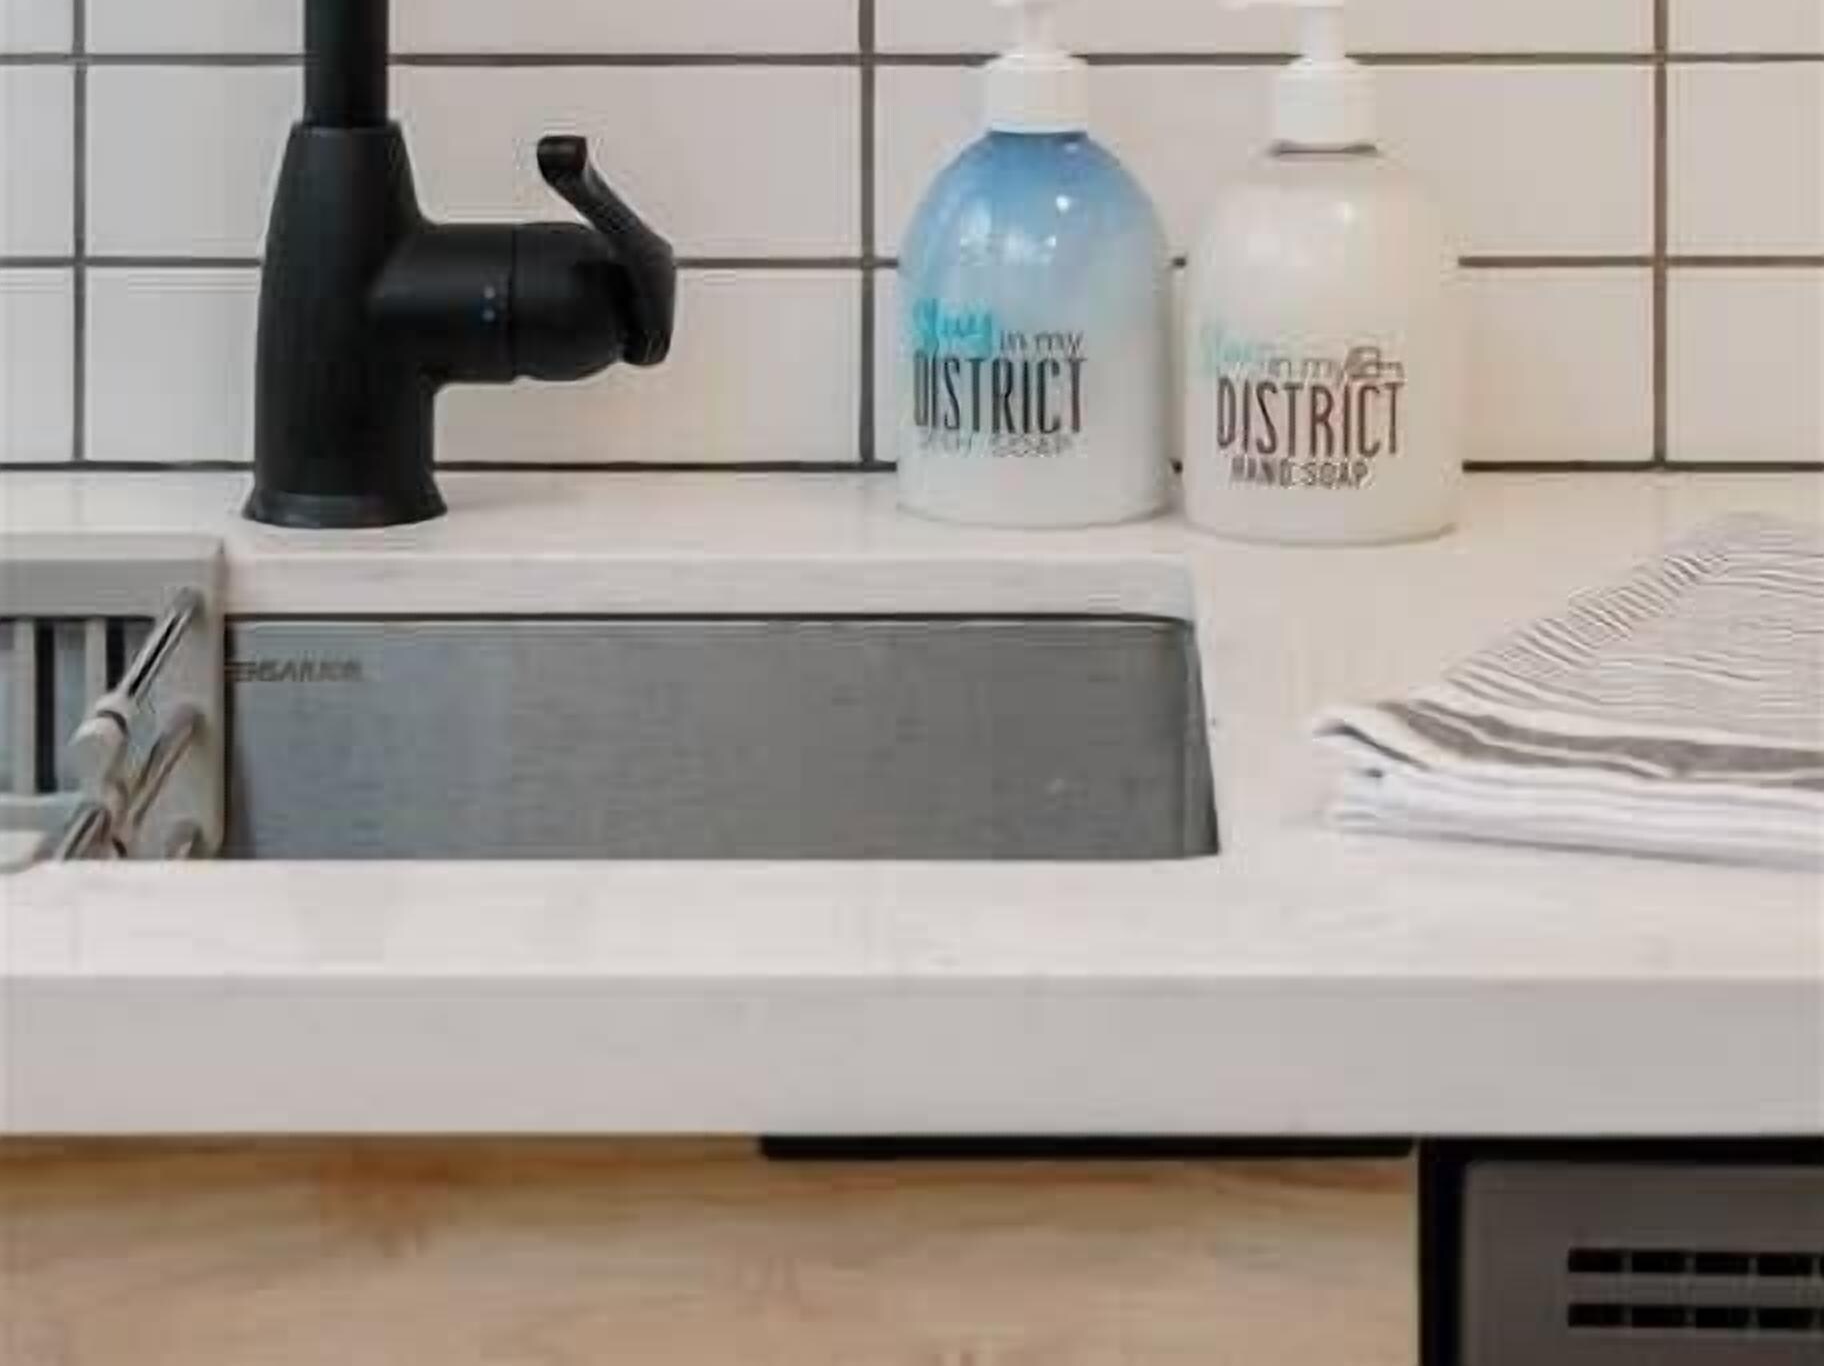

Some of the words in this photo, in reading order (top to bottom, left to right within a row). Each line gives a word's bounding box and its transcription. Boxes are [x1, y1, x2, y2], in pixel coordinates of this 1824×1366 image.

[999, 329, 1028, 352] in
[1035, 329, 1084, 357] my
[913, 349, 1087, 435] DISTRICT
[1216, 377, 1405, 458] DISTRICT
[1231, 456, 1294, 487] HAND
[1299, 459, 1371, 488] SOAP
